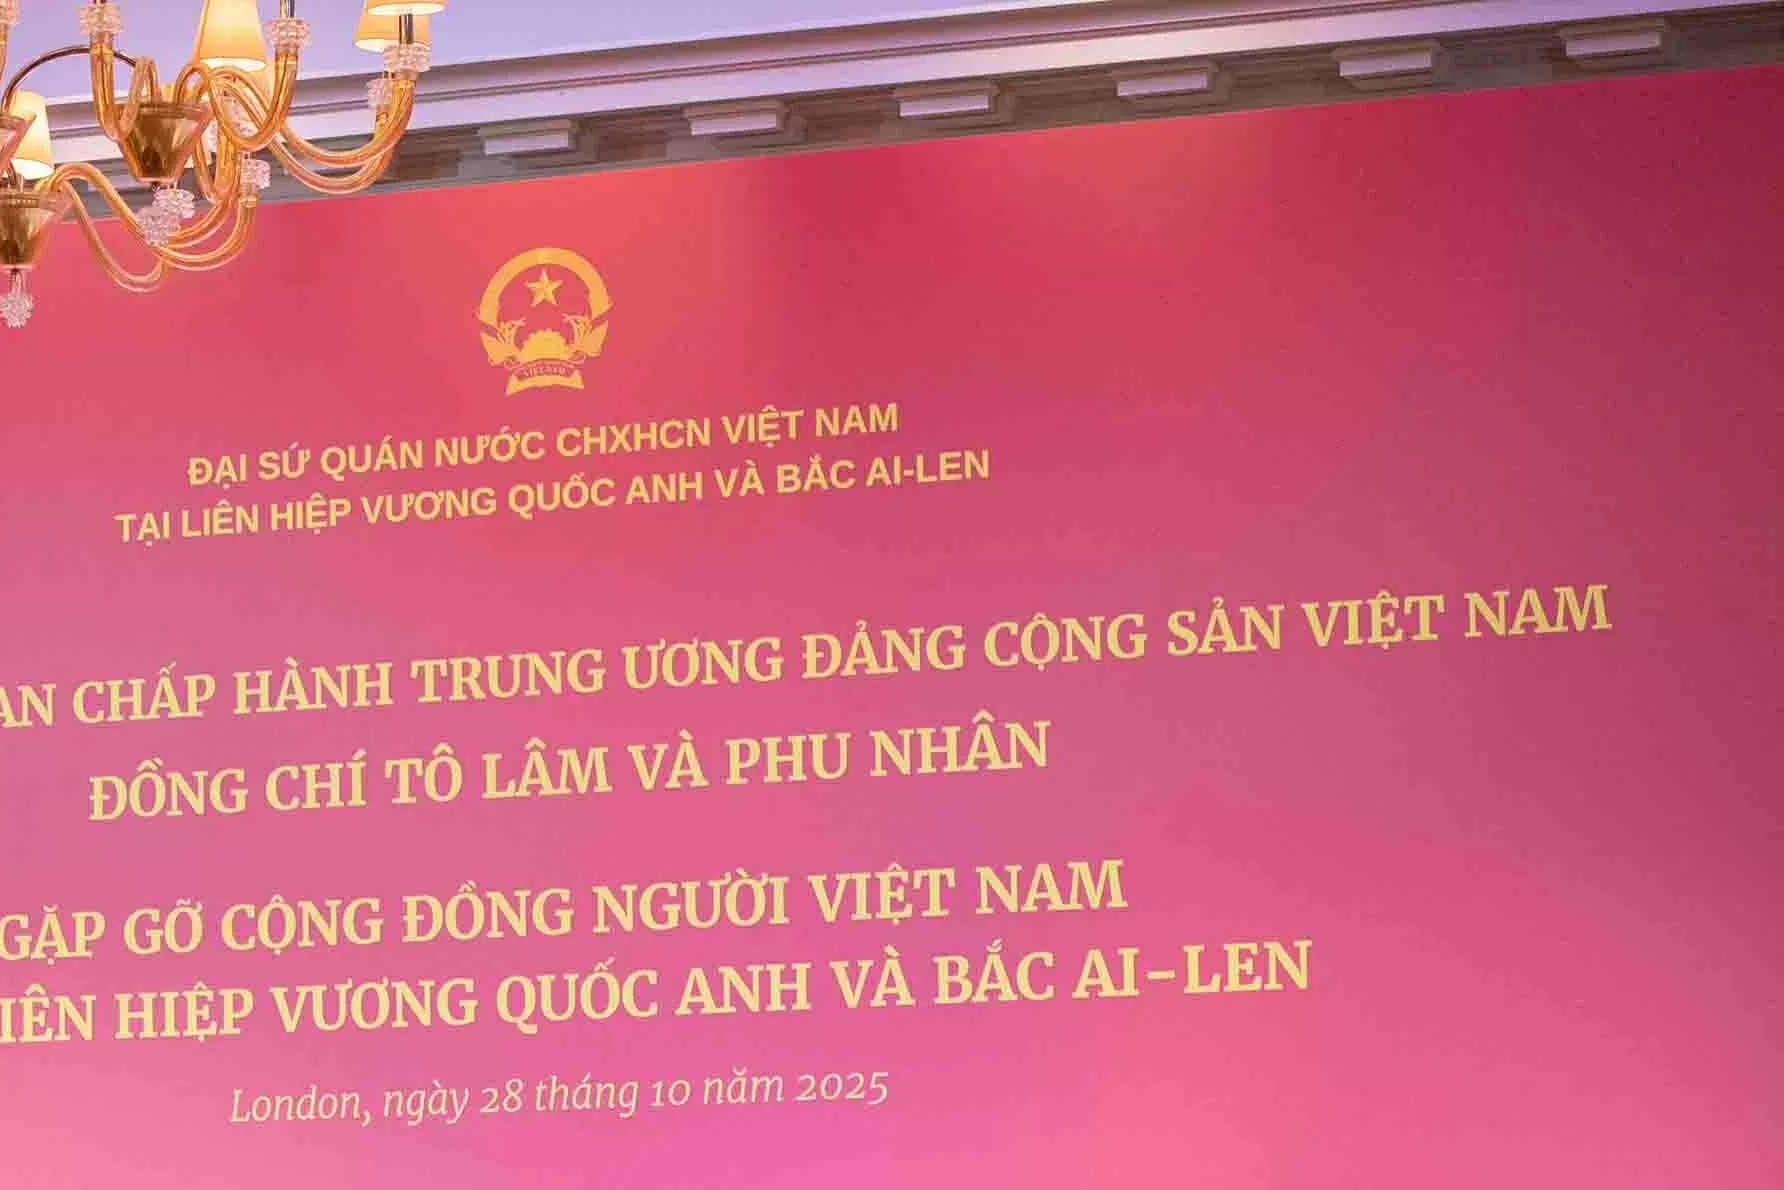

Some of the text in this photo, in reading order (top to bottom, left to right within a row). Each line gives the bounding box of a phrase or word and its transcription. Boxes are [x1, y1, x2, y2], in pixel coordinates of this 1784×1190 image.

[187, 402, 898, 490] ĐẠI SỨ QUÁN NƯỚC CHXHCN VIỆT NAM
[114, 448, 989, 547] TẠI LIÊN HIỆP VƯƠNG QUỐC ANH VÀ BẮC AI-LEN
[72, 661, 216, 724] CHẤP
[233, 655, 394, 715] HÀNH
[410, 648, 607, 703] TRUNG
[621, 636, 785, 689] ƯƠNG
[801, 619, 967, 679] ĐẢNG
[983, 612, 1148, 671] CỘNG
[1167, 596, 1285, 657] SẢN
[1300, 589, 1445, 650] VIỆT
[1463, 583, 1613, 638] NAM
[88, 709, 1051, 821] ĐỒNG CHÍ TÔ LÂM VÀ PHU NHÂN
[123, 898, 203, 955] GỠ
[221, 894, 385, 956] CỘNG
[402, 879, 575, 943] ĐỒNG
[591, 867, 790, 934] NGƯỜI
[807, 862, 956, 926] VIỆT
[975, 859, 1129, 914] NAM
[114, 980, 254, 1042] HIỆP
[269, 976, 479, 1033] VƯƠNG
[496, 957, 658, 1035] QUỐC
[674, 962, 812, 1016] ANH
[829, 943, 917, 1009] VÀ
[932, 938, 1055, 1004] BẮC
[1071, 939, 1313, 999] AI-LEN
[230, 1067, 889, 1127] London, ngày 28 tháng 10 năm 2025
